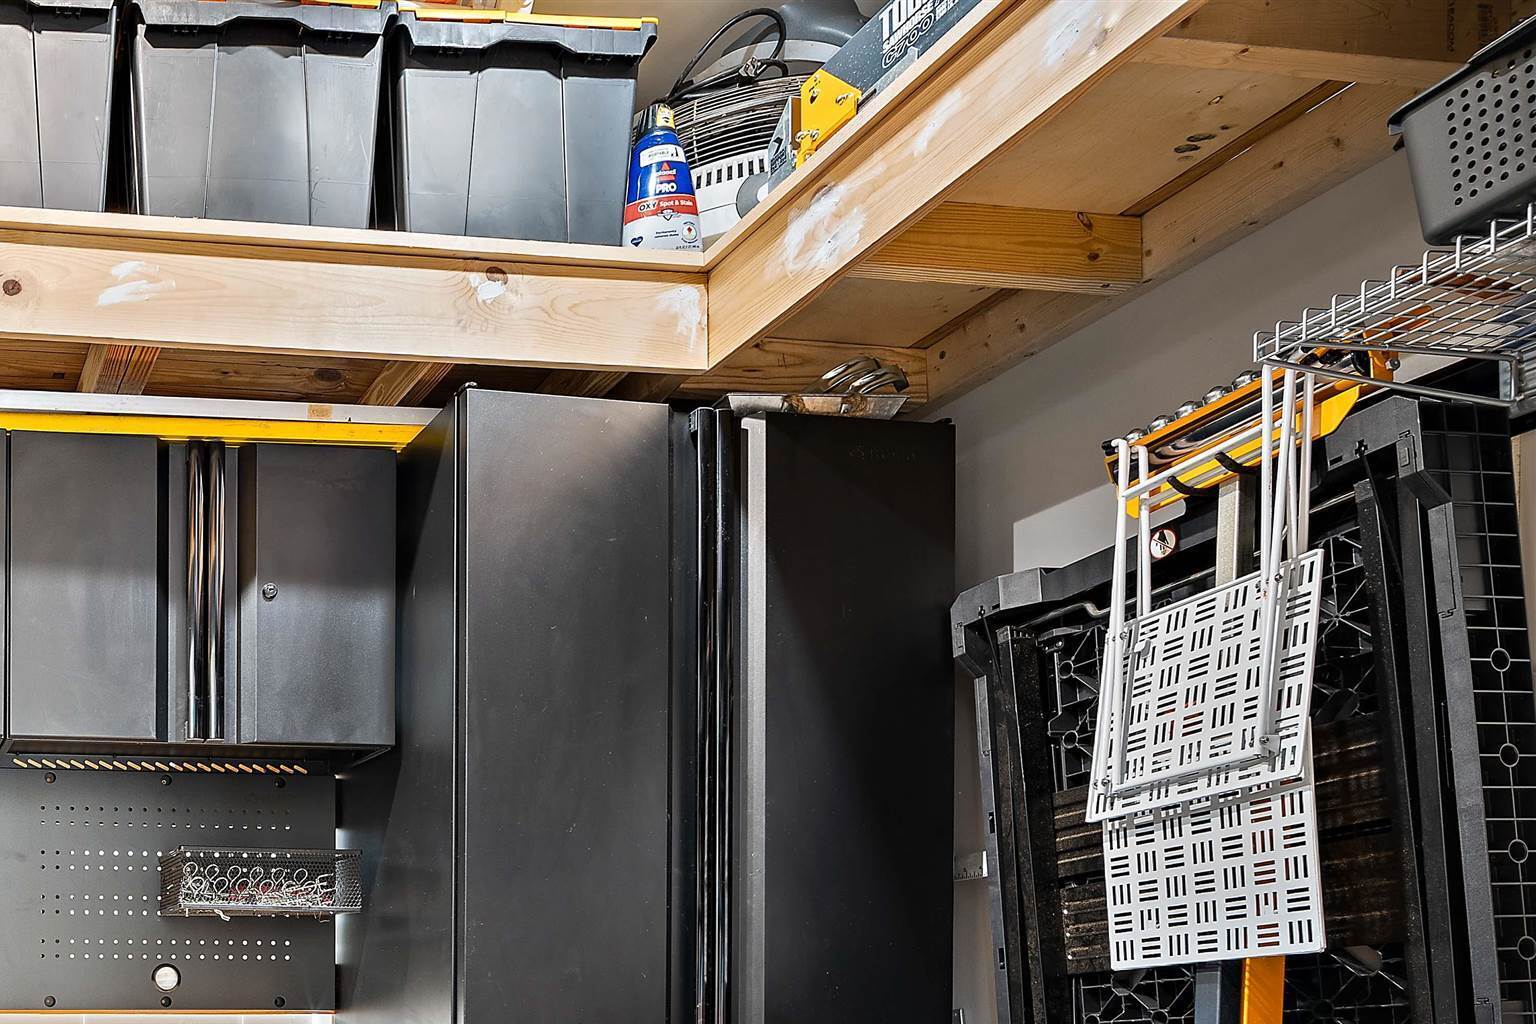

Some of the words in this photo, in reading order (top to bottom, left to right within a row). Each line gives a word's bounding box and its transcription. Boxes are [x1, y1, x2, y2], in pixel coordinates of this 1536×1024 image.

[882, 12, 934, 68] C700
[656, 182, 677, 193] PRO
[638, 201, 657, 212] OXY
